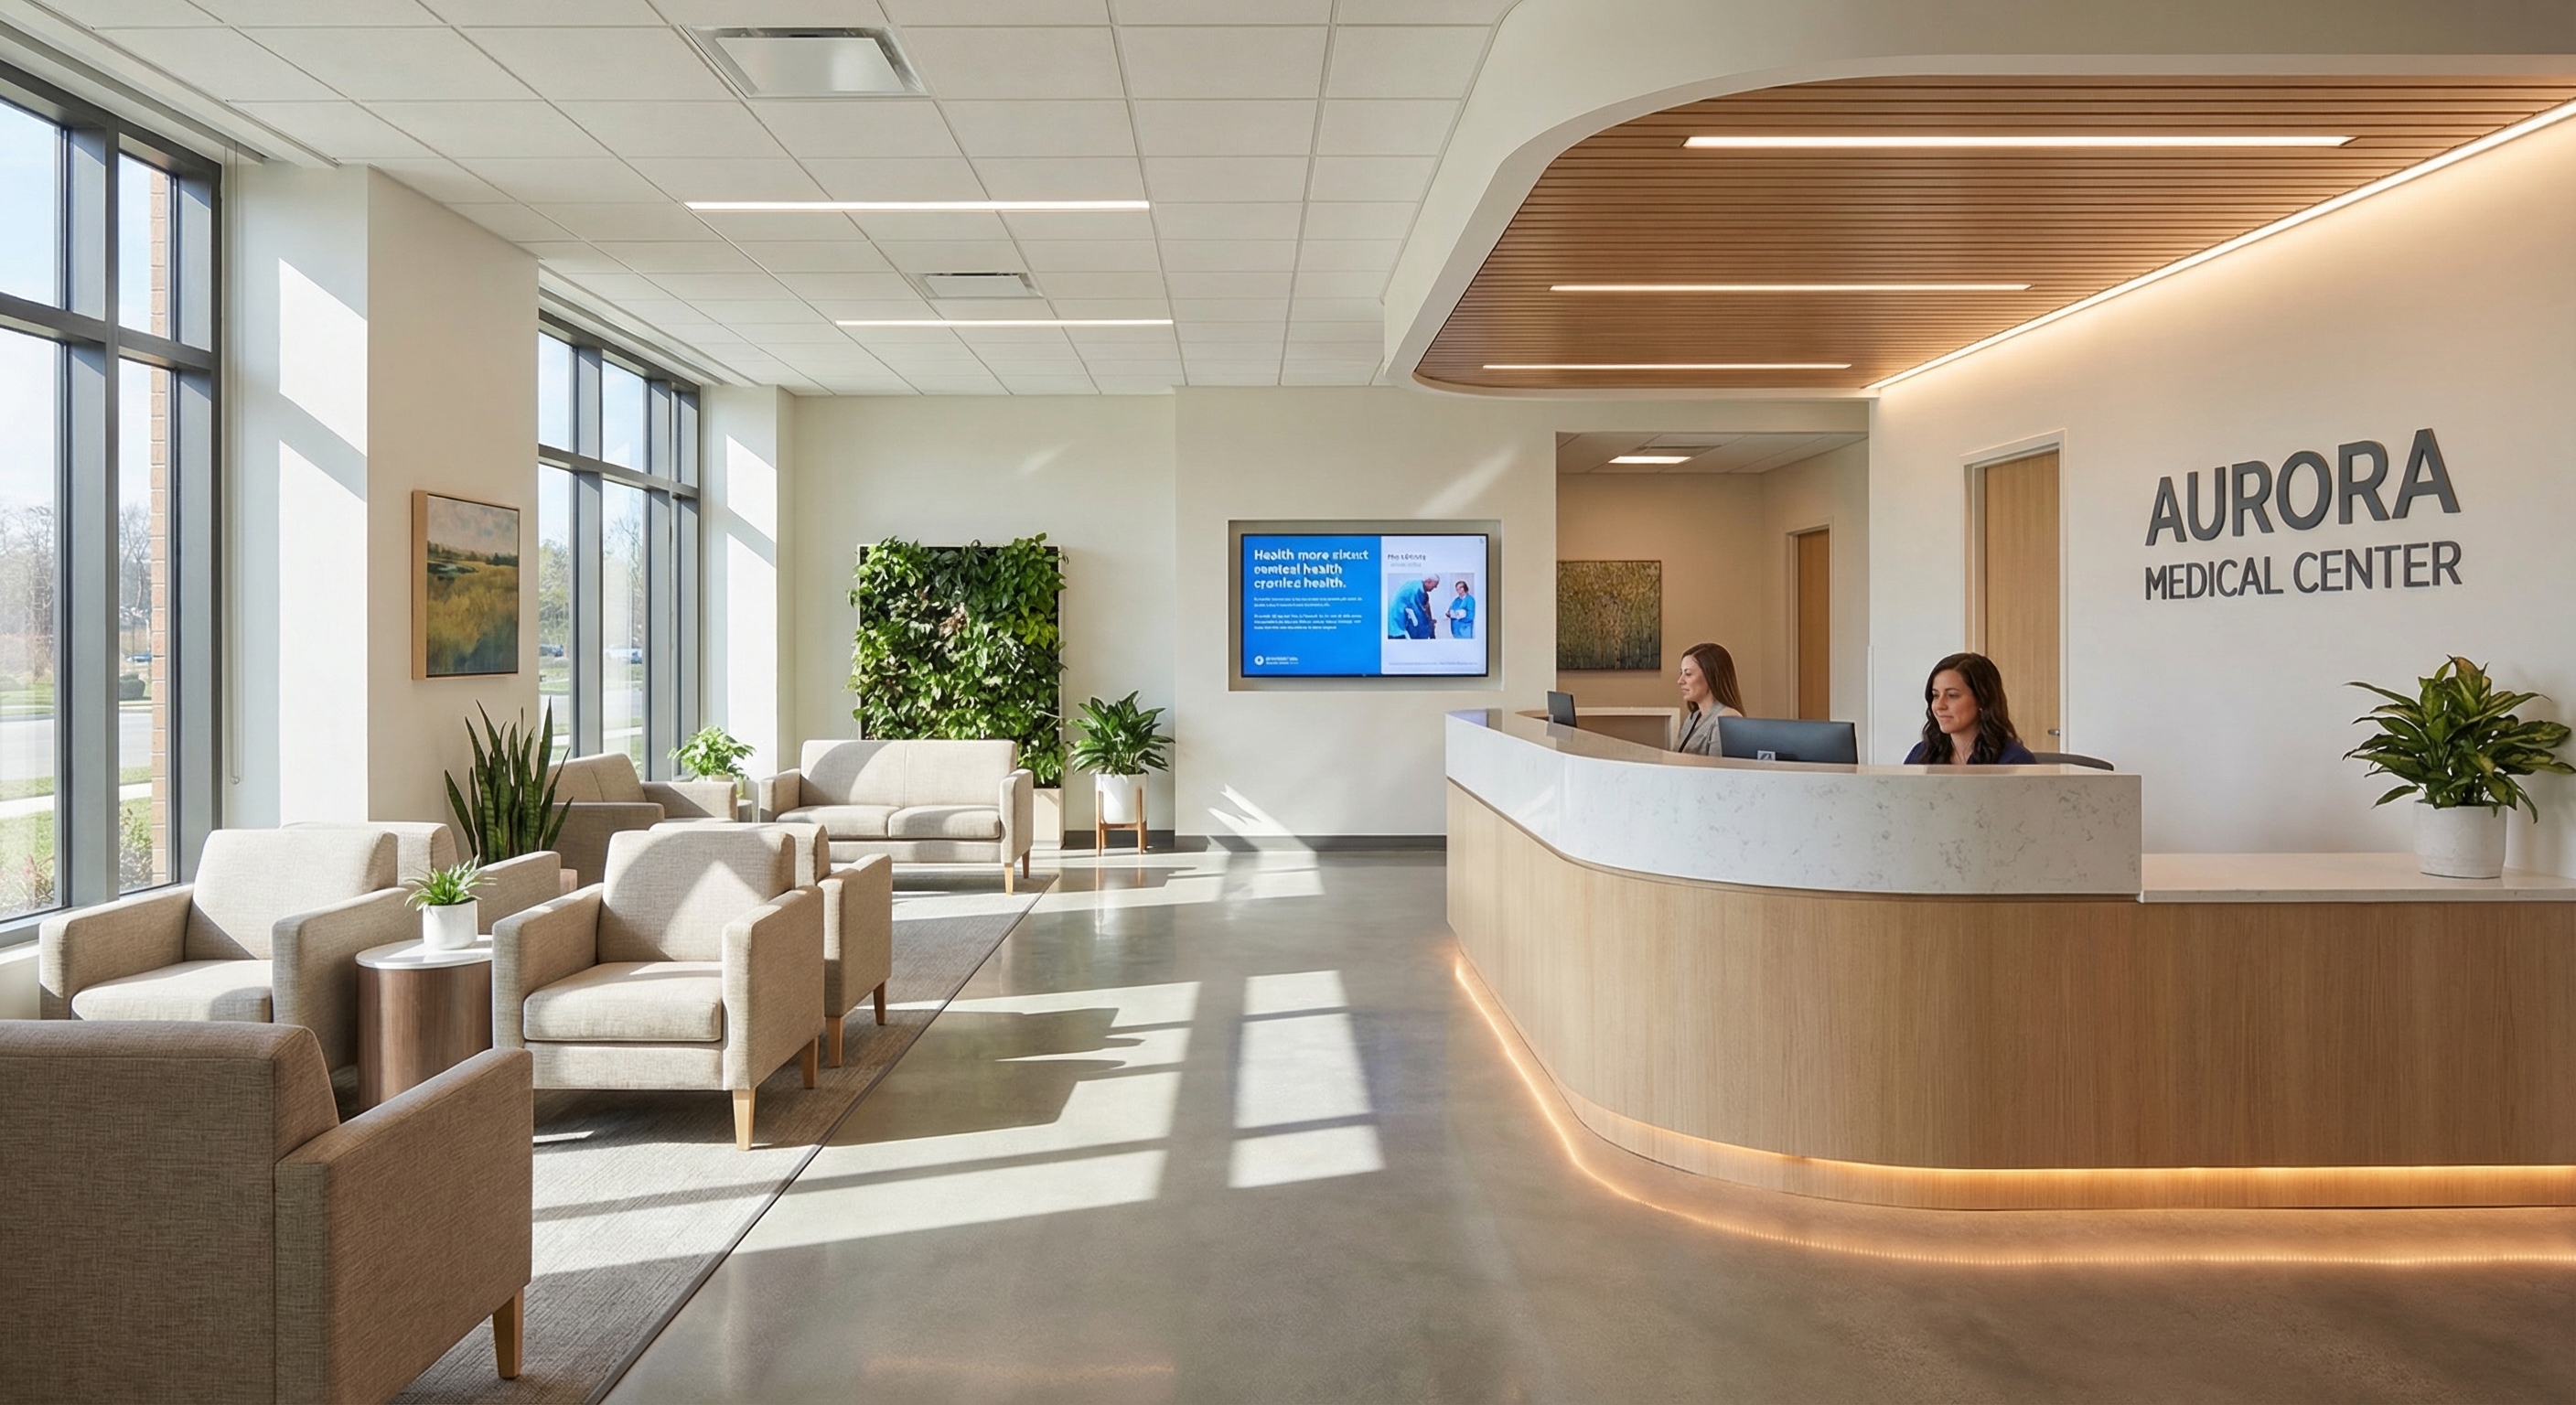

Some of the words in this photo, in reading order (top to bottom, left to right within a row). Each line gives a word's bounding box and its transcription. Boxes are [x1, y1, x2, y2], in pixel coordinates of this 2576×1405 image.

[2145, 428, 2461, 546] AURORA
[1254, 549, 1294, 561] Health
[1298, 551, 1330, 561] more
[1304, 563, 1343, 574] health
[2145, 554, 2284, 600] MEDICAL
[2293, 541, 2463, 593] CENTER
[1304, 577, 1347, 588] health.
